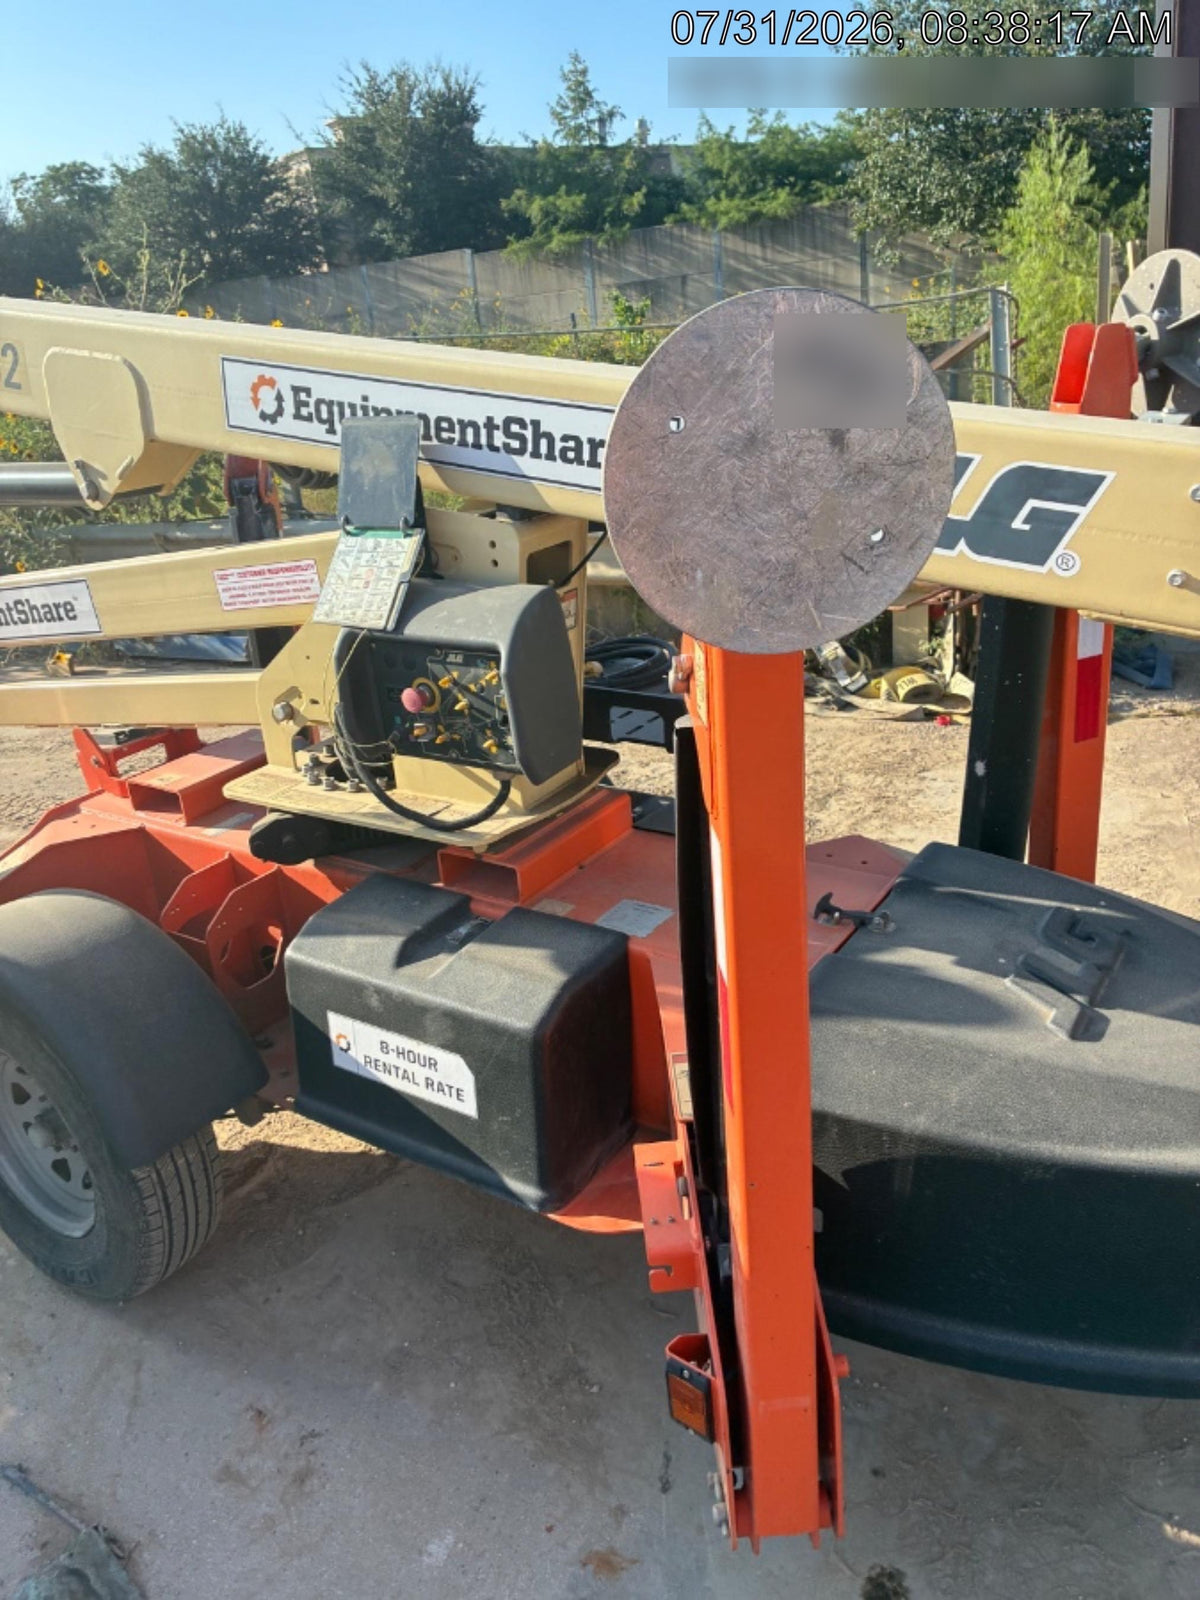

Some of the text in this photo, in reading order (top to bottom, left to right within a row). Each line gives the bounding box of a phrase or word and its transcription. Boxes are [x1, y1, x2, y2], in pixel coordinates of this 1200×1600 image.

[379, 1040, 439, 1073] 8-HOUR
[363, 1054, 466, 1103] RENTAL RATE
